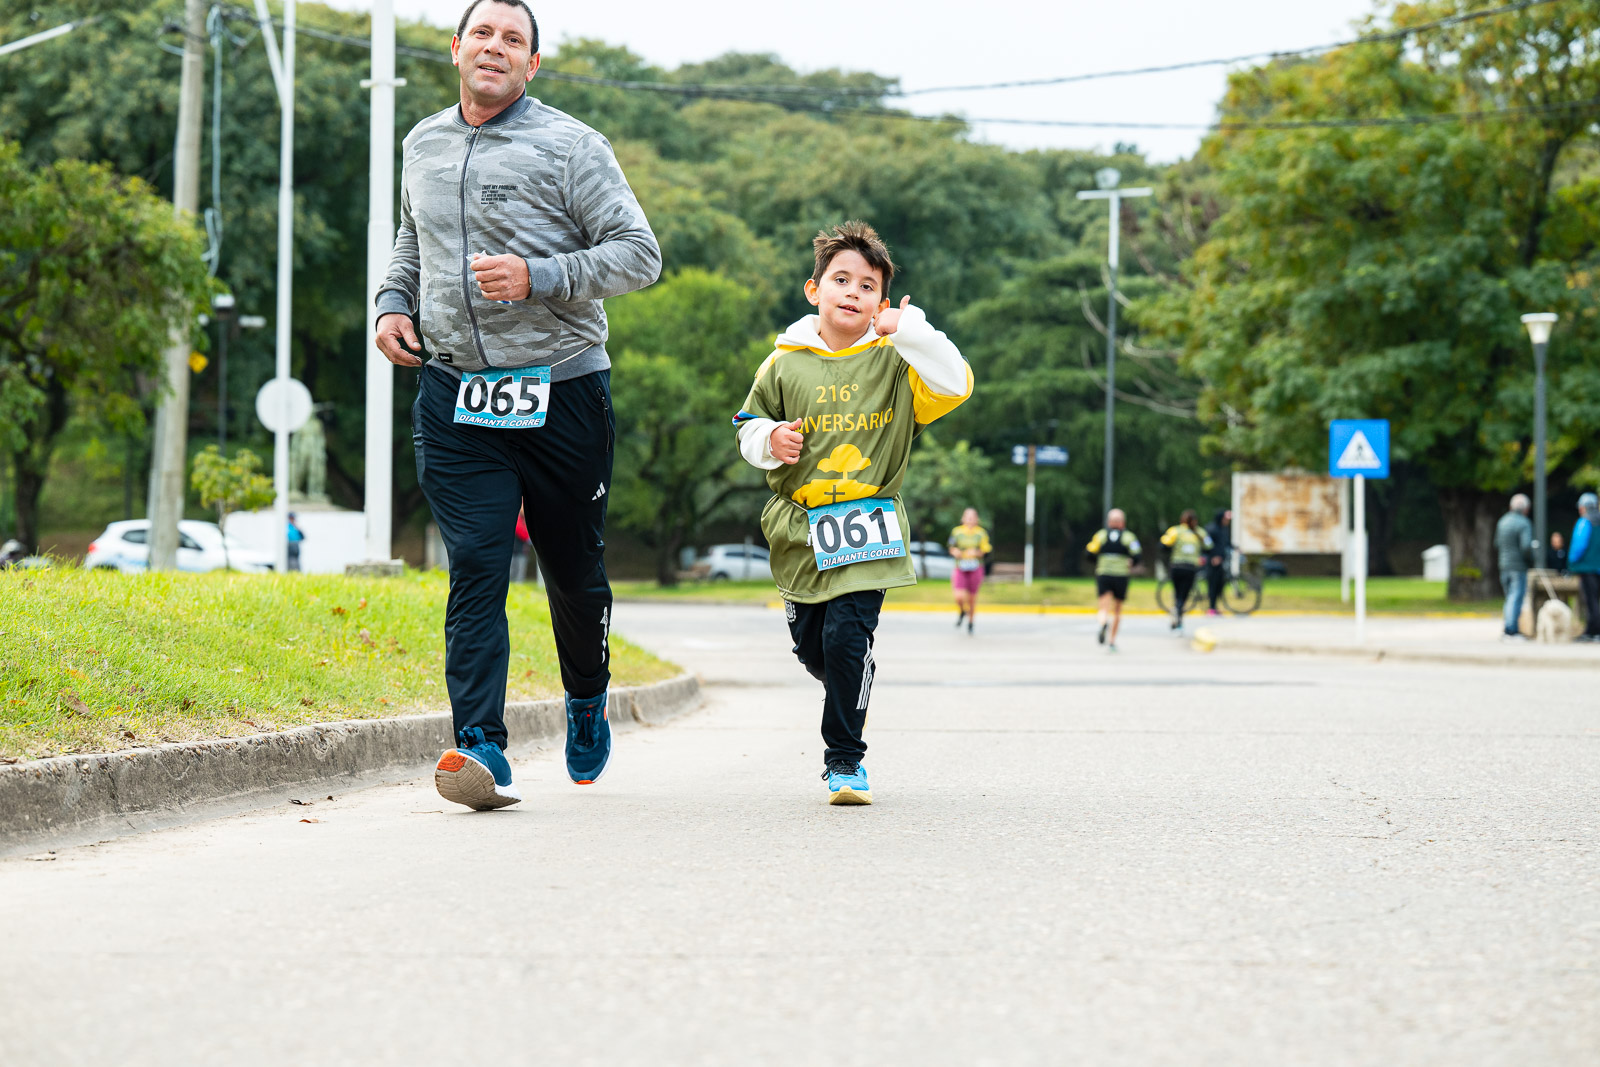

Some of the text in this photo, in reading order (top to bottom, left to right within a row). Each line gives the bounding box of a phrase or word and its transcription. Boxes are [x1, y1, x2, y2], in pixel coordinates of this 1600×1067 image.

[464, 375, 541, 417] 065
[815, 383, 859, 404] 216°
[458, 414, 541, 427] DIAMANTE CORRE
[794, 407, 894, 434] IVERSARIO
[816, 506, 890, 555] 061
[822, 547, 900, 568] DIAMANTE CORRE
